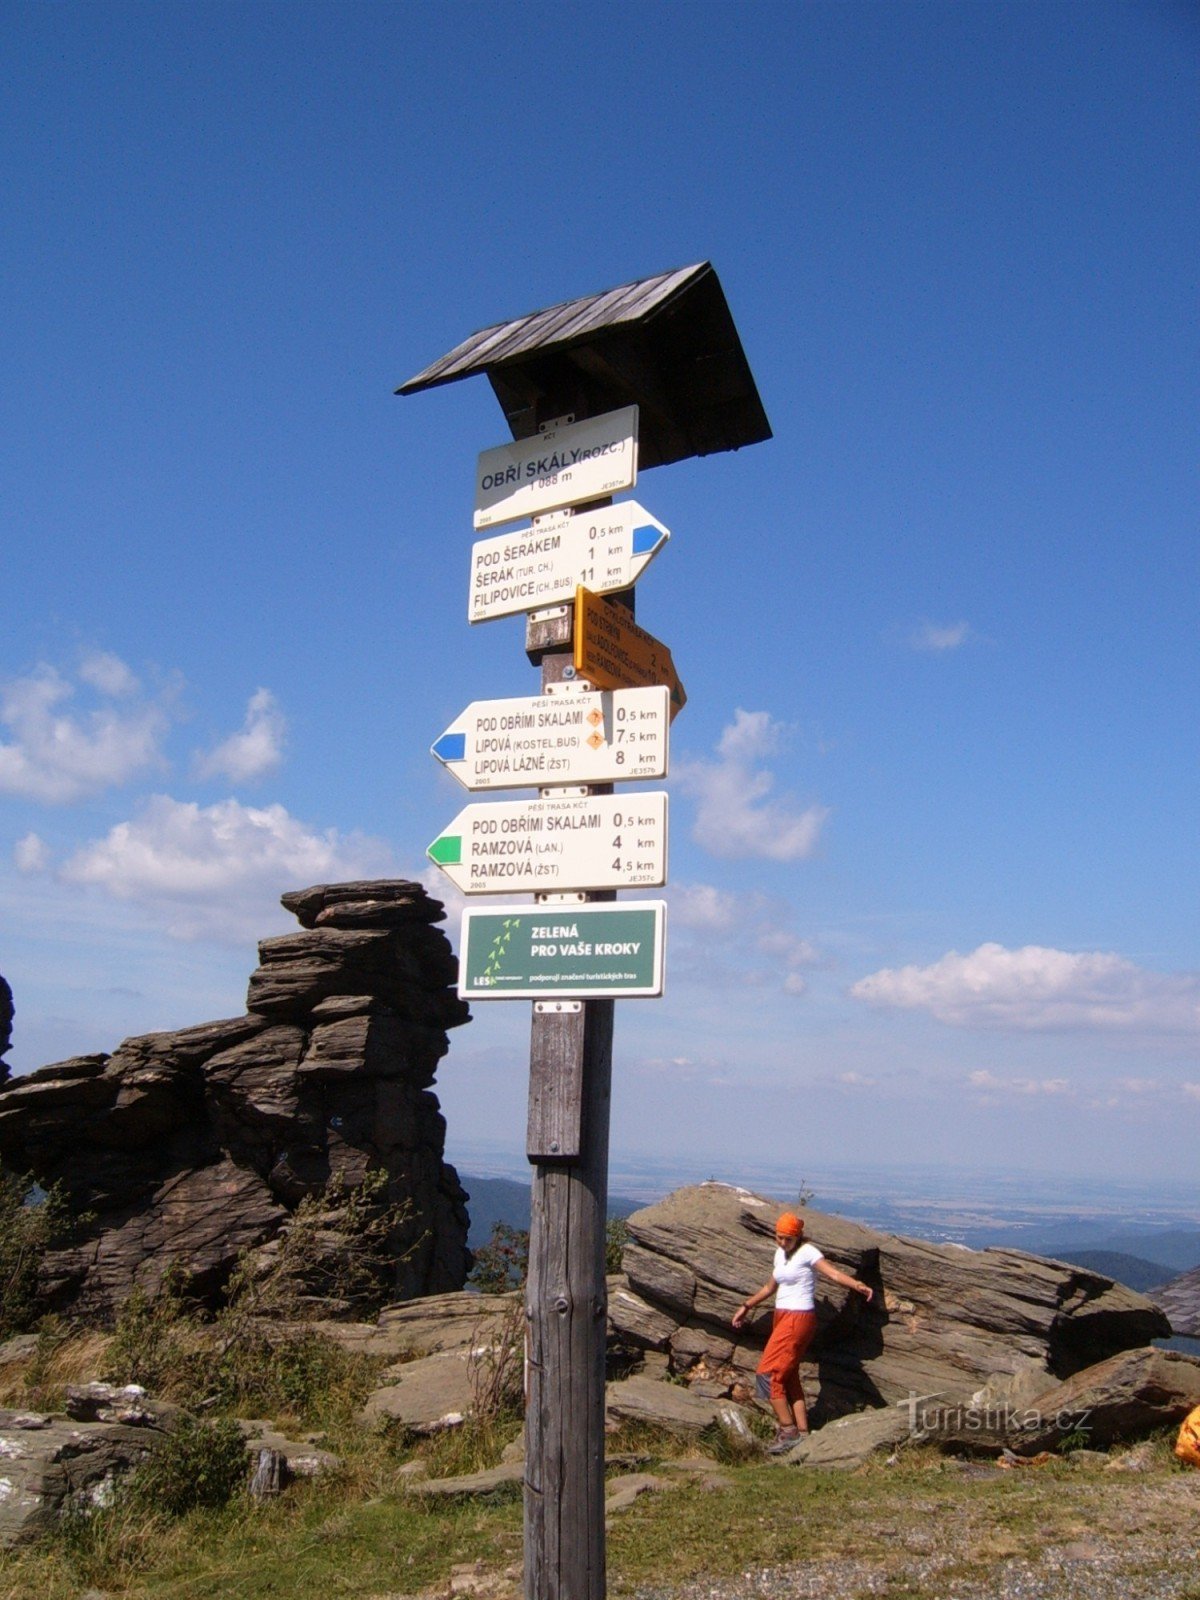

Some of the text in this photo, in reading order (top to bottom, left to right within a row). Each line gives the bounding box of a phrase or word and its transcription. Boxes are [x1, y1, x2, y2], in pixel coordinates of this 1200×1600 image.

[481, 462, 522, 490] OBŘÍ
[526, 448, 581, 477] SKÁLY
[538, 474, 558, 489] 088
[561, 472, 572, 482] m
[536, 526, 556, 534] TRASA
[557, 521, 570, 529] KČT
[476, 525, 624, 569] POD ŠERÁKEM 0,5 km
[475, 546, 623, 588] ŠERÁK (TUR. CH.) 1 km
[474, 581, 535, 608] FILIPOVICE
[580, 566, 594, 582] 11
[607, 567, 622, 577] km
[576, 697, 592, 705] KČT
[476, 707, 657, 732] POD OBŘÍMI SKALAMI 0,5 km
[475, 734, 511, 753] LIPOVÁ
[616, 729, 636, 744] 7,5
[639, 732, 657, 742] km
[474, 750, 656, 774] LIPOVÁ LÁZNĚ (ŽST) 8 km
[573, 801, 588, 809] KČT
[472, 812, 656, 835] POD OBŘÍMI SKALAMI 0,5 km
[471, 835, 655, 856] RAMZOVÁ (LAN.) 4 km
[470, 857, 655, 878] RAMZOVÁ (ŽST) 4,5 km
[531, 923, 579, 939] ZELENÁ
[530, 941, 641, 957] PRO VAŠE KROKY
[624, 972, 637, 980] tras
